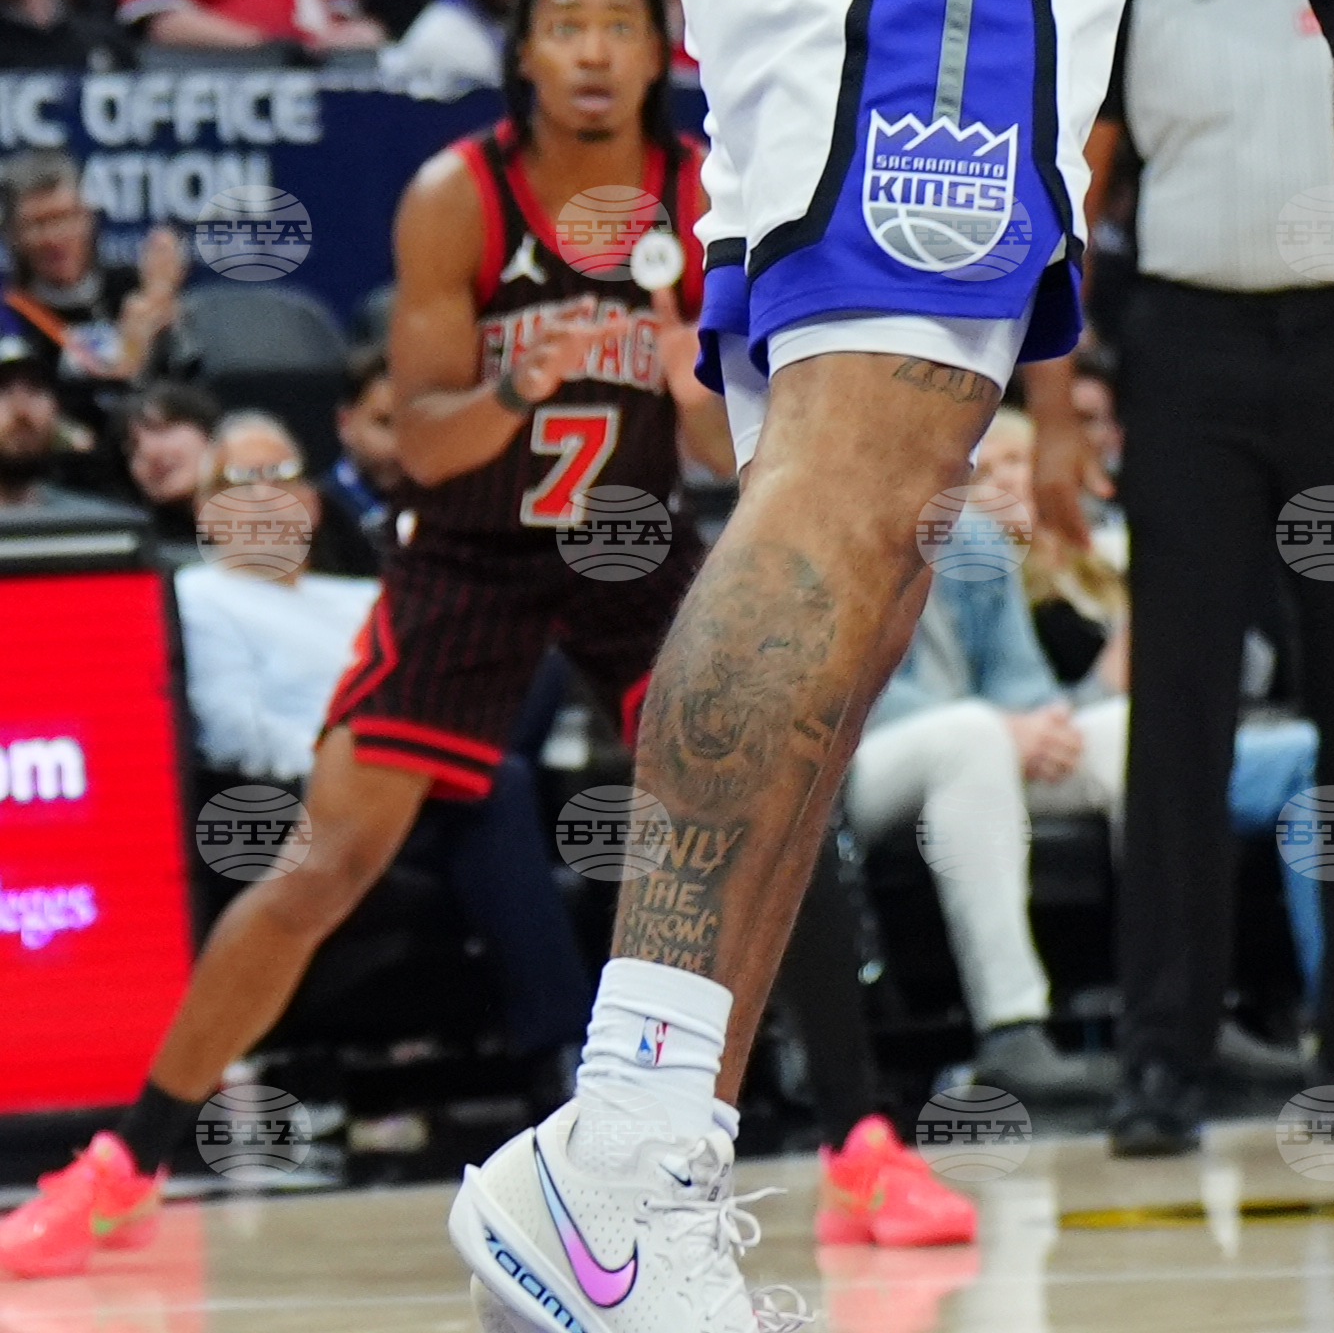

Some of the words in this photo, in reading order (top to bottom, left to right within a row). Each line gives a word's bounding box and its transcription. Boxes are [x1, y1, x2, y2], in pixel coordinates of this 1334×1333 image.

[80, 70, 325, 147] OFFICE
[869, 175, 1007, 213] KINGS
[875, 153, 1006, 179] SACRAMENTO
[520, 404, 622, 528] 7
